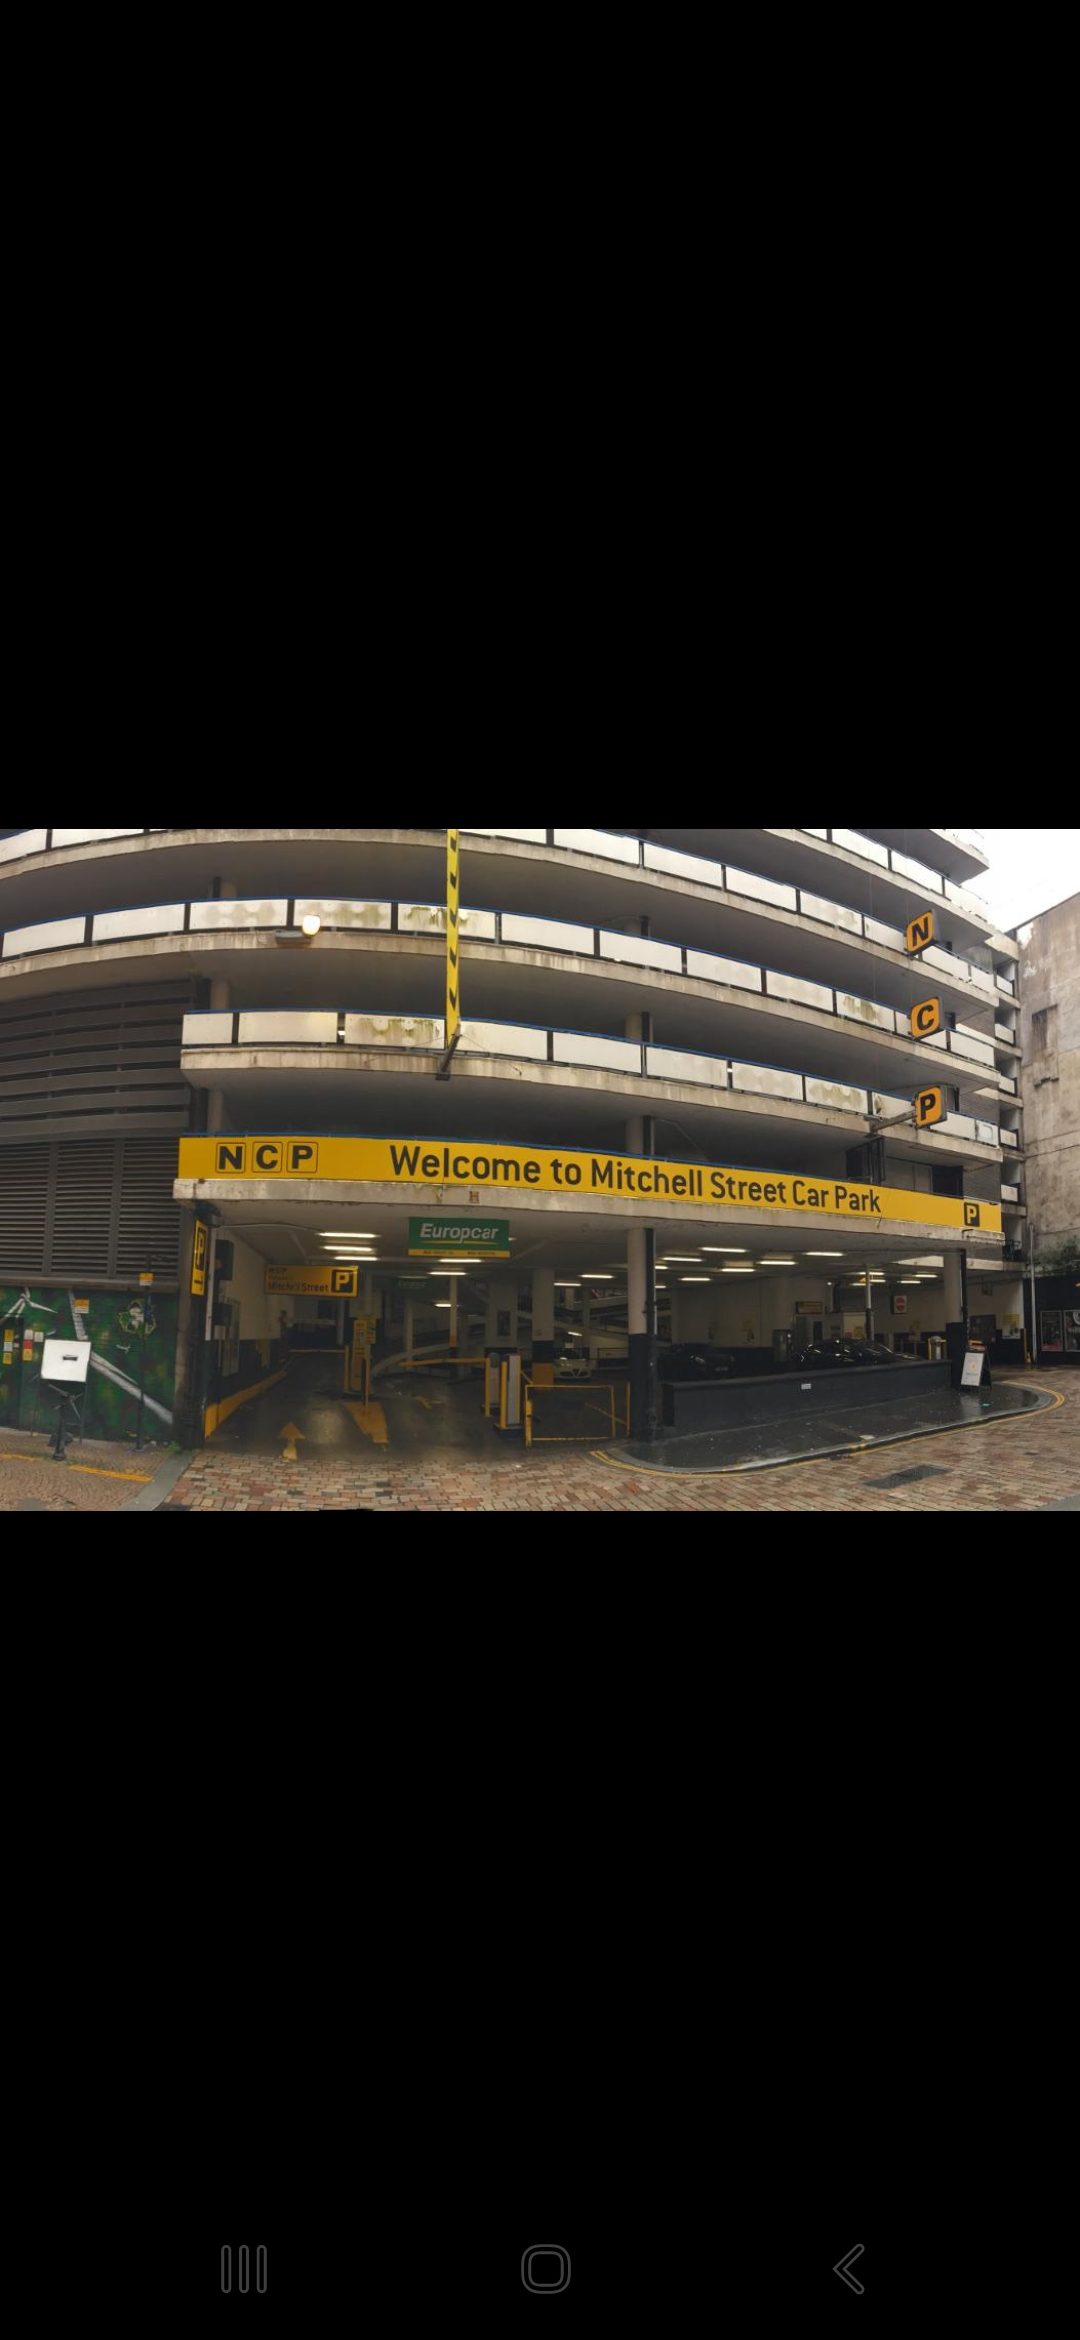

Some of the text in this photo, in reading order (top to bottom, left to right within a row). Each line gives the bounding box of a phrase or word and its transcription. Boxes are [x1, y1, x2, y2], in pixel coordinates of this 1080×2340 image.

[911, 916, 929, 947] N
[916, 1004, 935, 1031] C
[919, 1093, 936, 1121] P
[218, 1144, 313, 1170] NCP
[390, 1145, 881, 1213] Welcome to Mitchell Street Car Park
[419, 1223, 499, 1244] Europcar
[302, 1282, 329, 1293] Street
[335, 1271, 350, 1291] P
